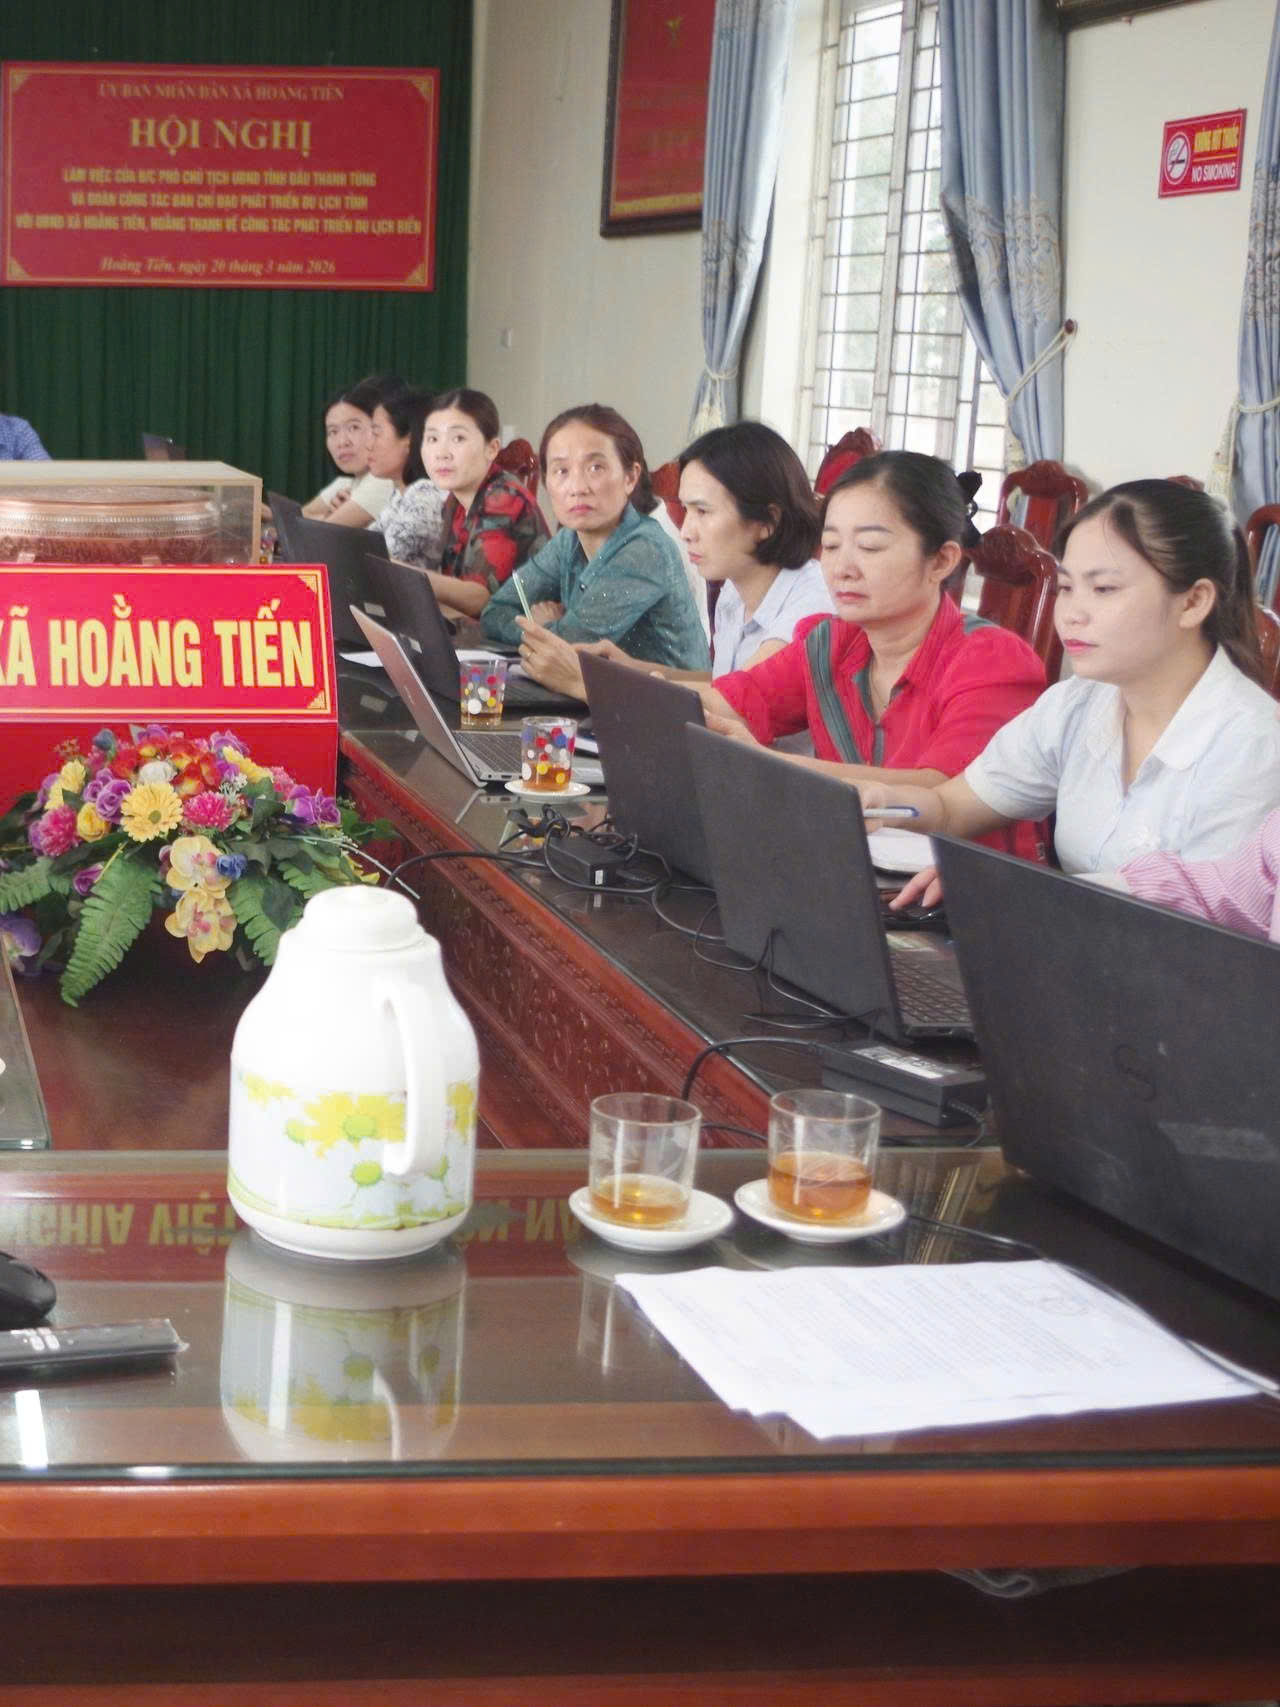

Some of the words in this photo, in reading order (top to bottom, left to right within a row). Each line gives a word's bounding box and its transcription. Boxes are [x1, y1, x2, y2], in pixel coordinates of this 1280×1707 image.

[130, 114, 200, 157] HỘI
[213, 118, 313, 159] NGHỊ
[1191, 166, 1202, 184] NO
[1203, 161, 1236, 181] SMOKING
[47, 593, 203, 687] HOẰNG
[213, 598, 315, 687] TIẾN
